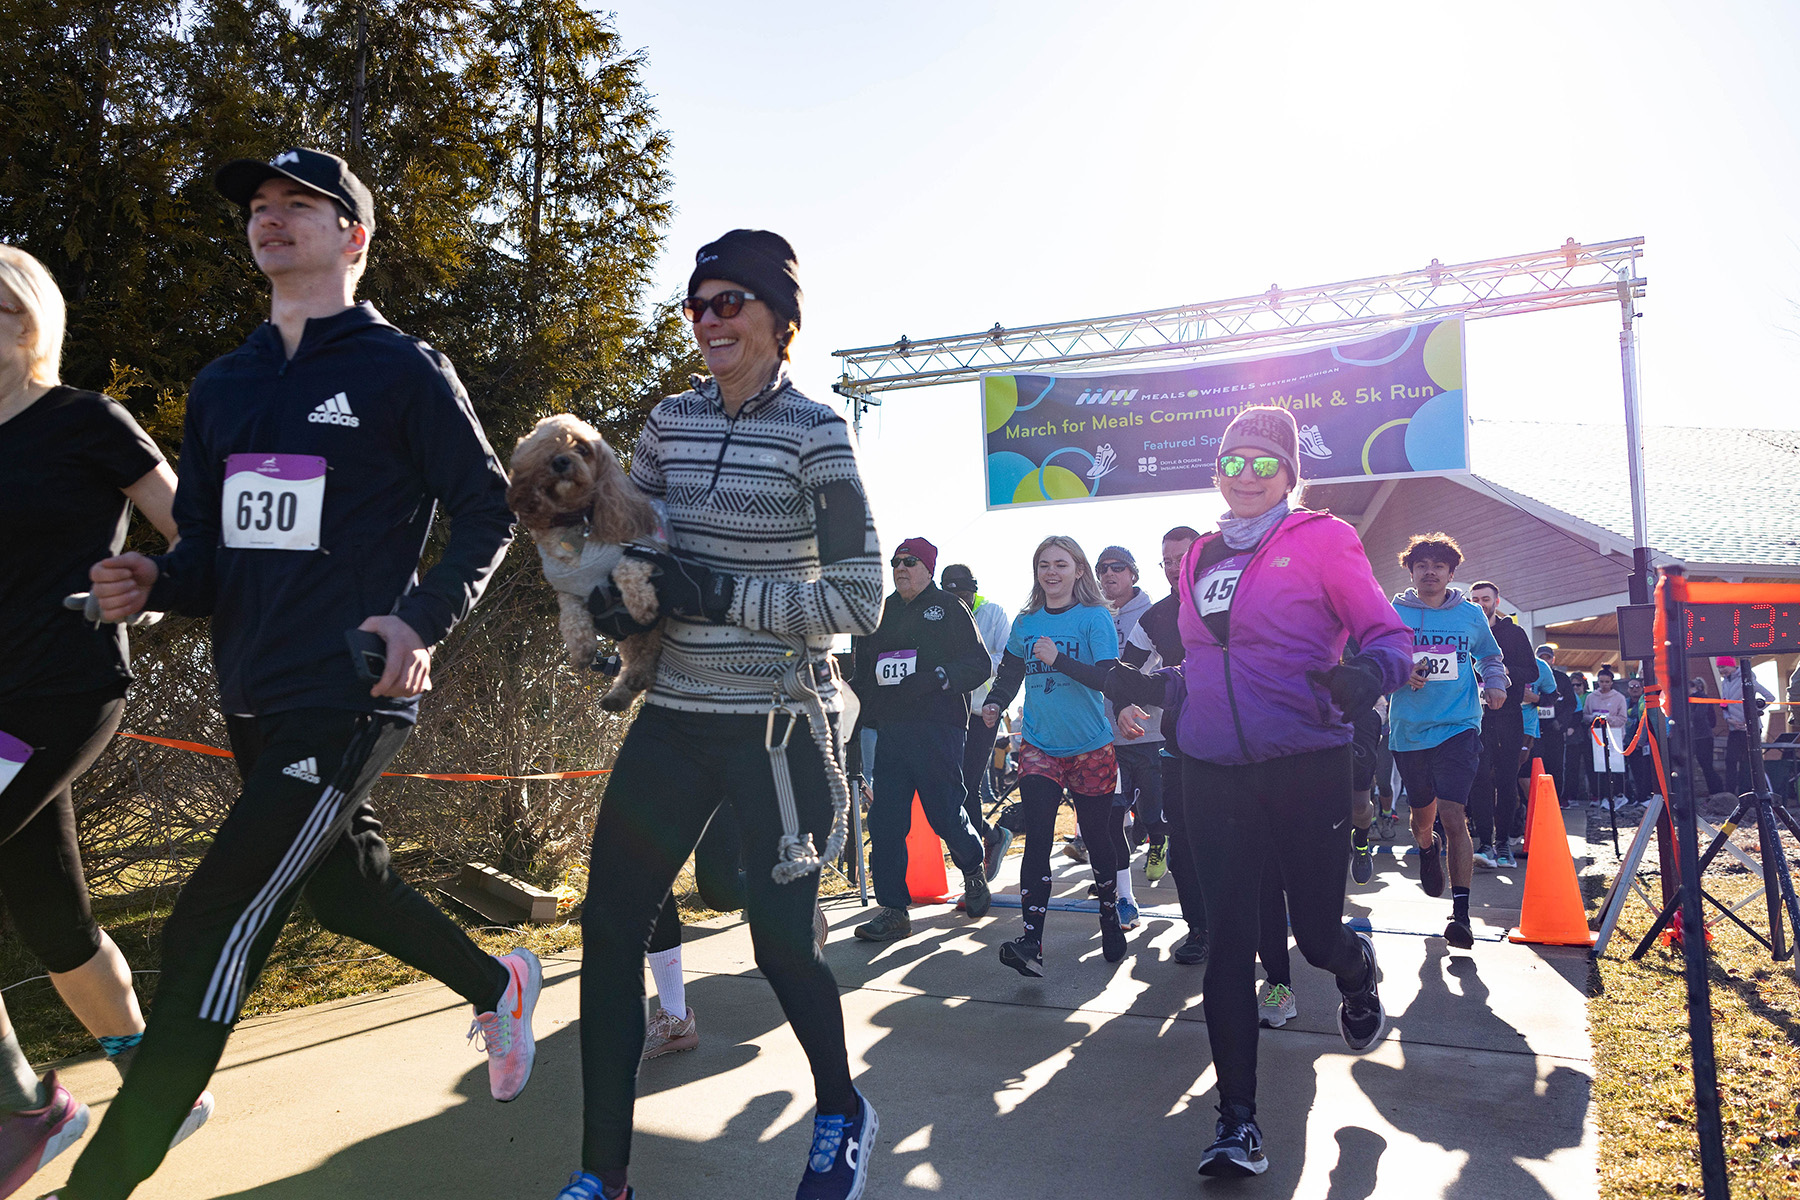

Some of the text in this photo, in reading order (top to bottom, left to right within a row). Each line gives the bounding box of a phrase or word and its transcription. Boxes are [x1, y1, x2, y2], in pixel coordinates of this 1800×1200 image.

[1141, 391, 1185, 401] MEALS
[1200, 382, 1256, 396] WHEELS
[1260, 377, 1297, 388] WESTERN
[1299, 367, 1340, 380] MICHIGAN
[308, 411, 360, 428] adidas
[1006, 421, 1057, 439] March
[1062, 419, 1086, 434] for
[1092, 411, 1144, 430] Meals
[1270, 392, 1322, 411] Walk
[1330, 390, 1348, 407] &
[1355, 387, 1382, 404] 5k
[1390, 384, 1434, 400] Run
[1143, 436, 1196, 451] Featured
[1240, 426, 1281, 443] FACE
[236, 490, 297, 532] 630
[1203, 576, 1238, 604] 45
[882, 662, 908, 680] 613
[282, 766, 321, 785] adidas
